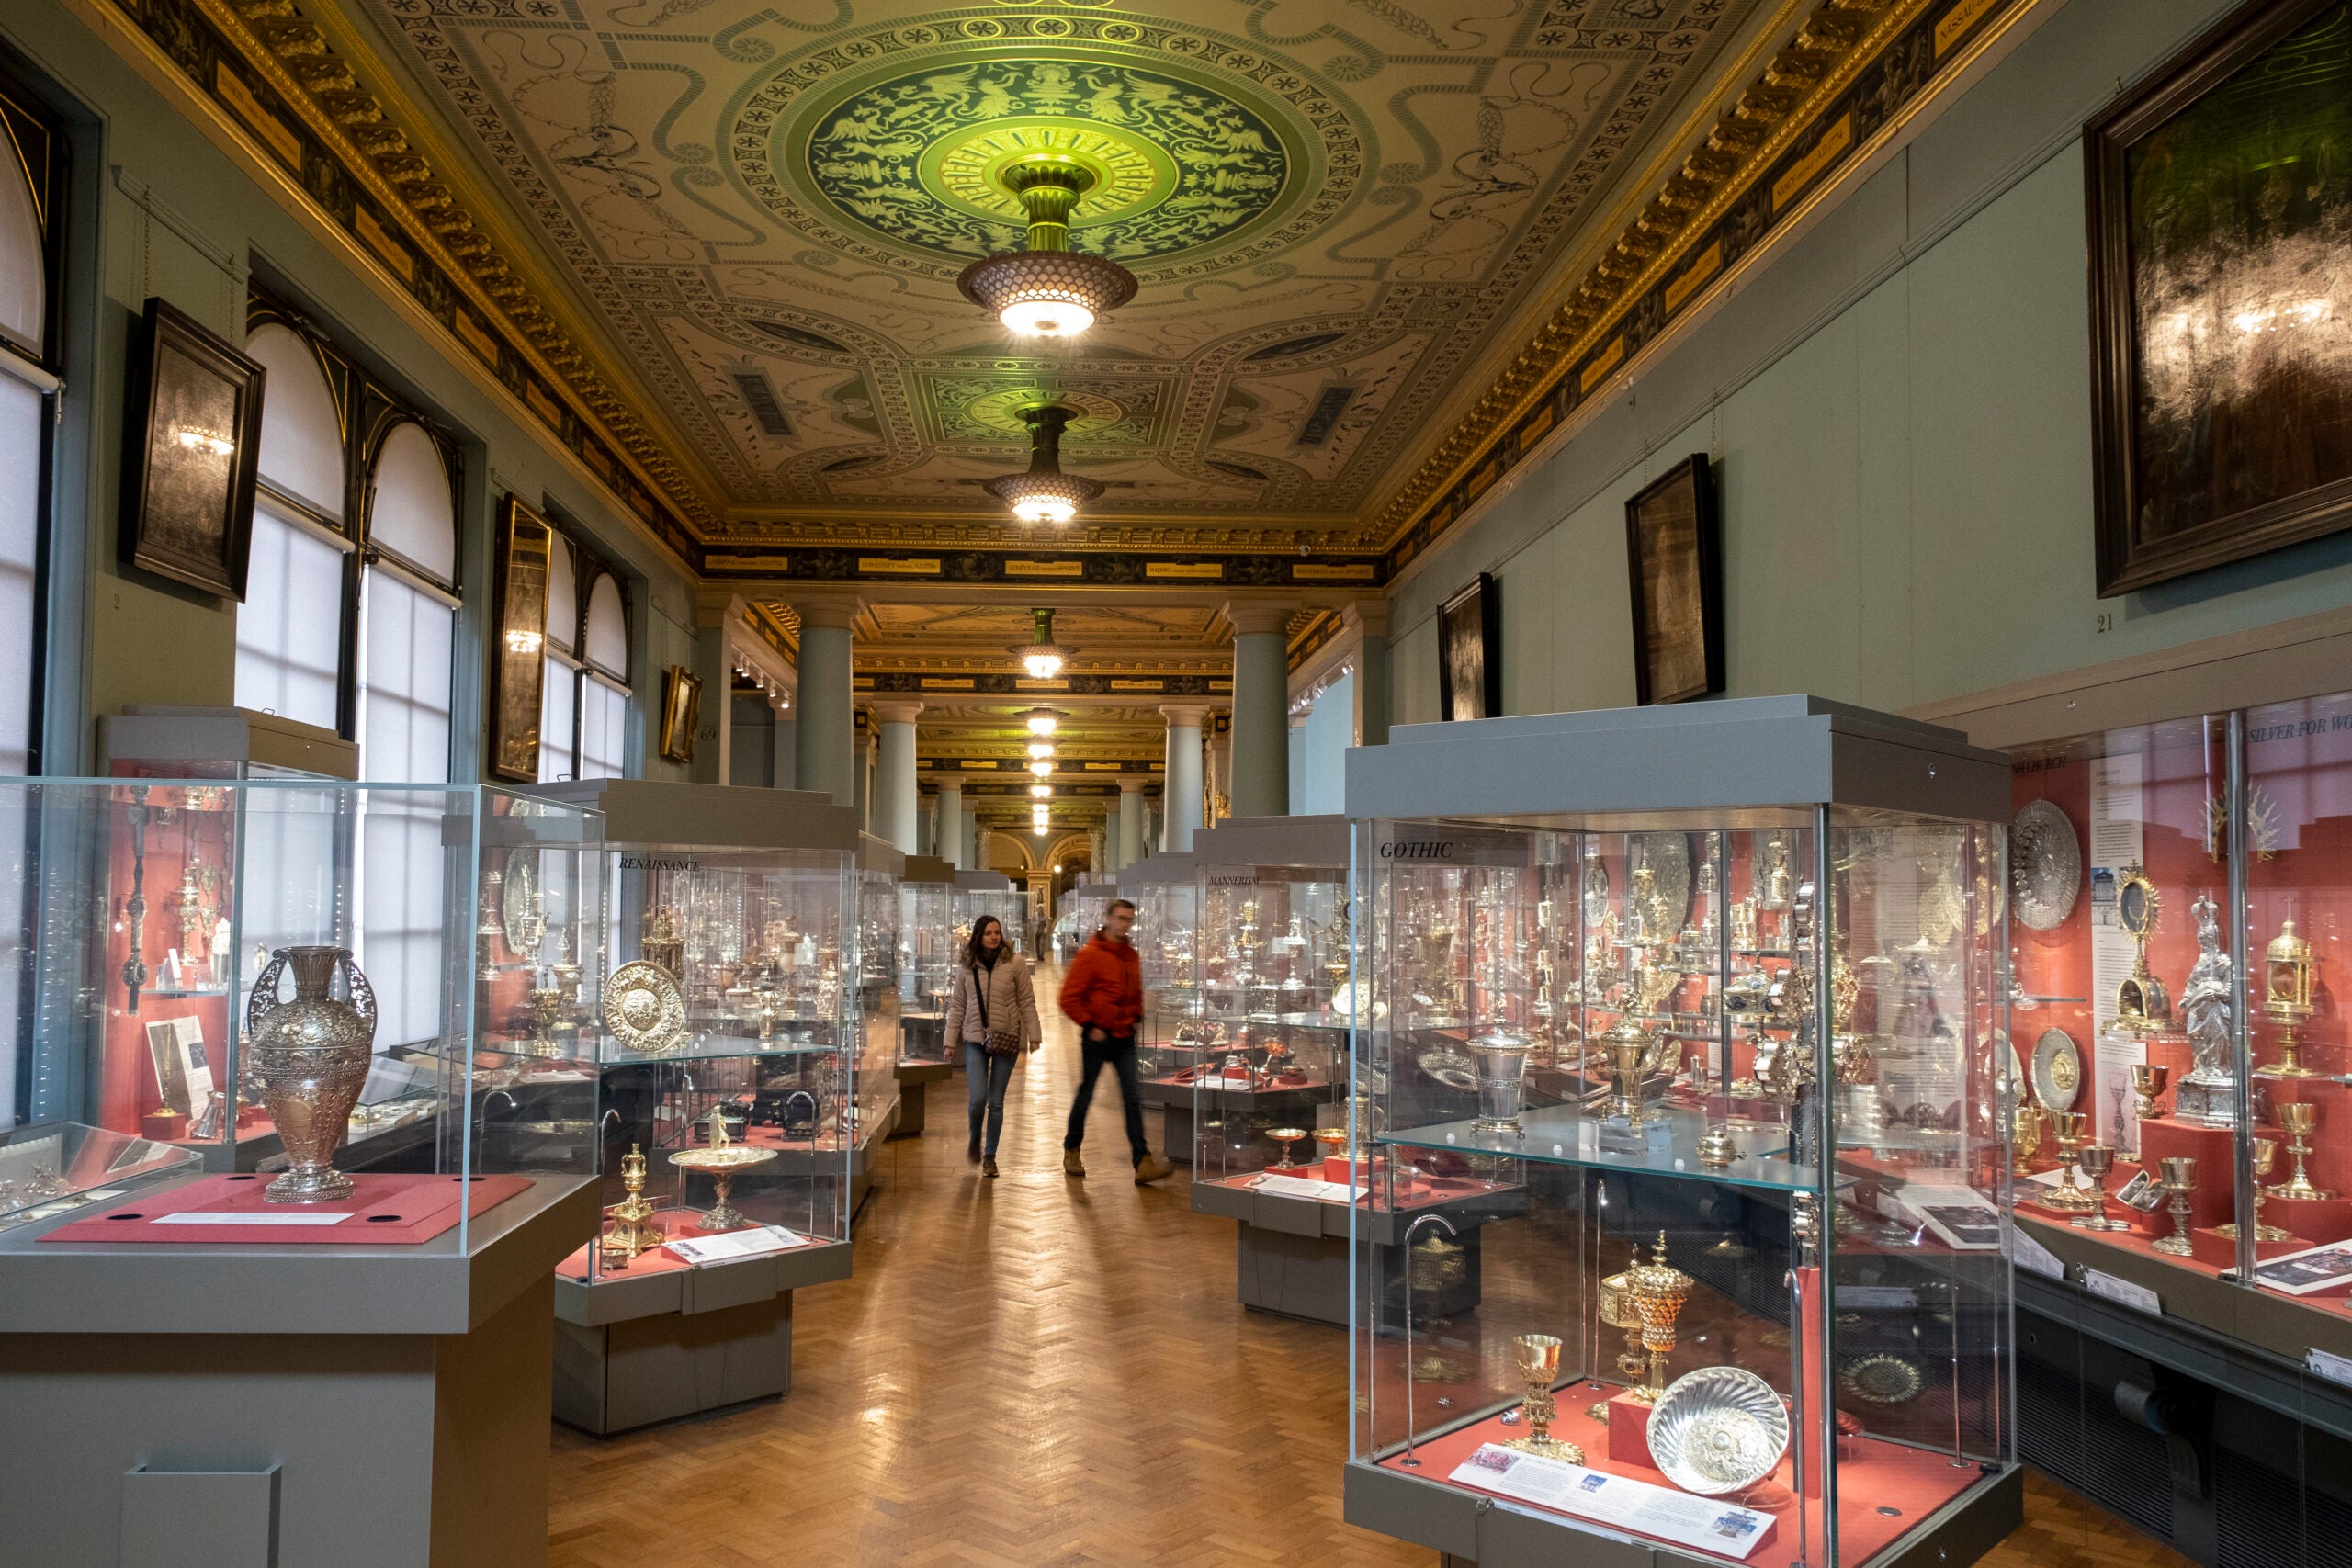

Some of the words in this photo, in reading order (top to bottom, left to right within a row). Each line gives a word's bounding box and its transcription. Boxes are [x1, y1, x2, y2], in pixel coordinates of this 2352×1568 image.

[2098, 613, 2113, 634] 21
[700, 728, 716, 741] 69
[2248, 723, 2294, 744] SILVER
[2299, 718, 2327, 737] FOR
[1380, 841, 1453, 859] GOTHIC
[618, 857, 701, 872] RENAISSANCE
[1209, 875, 1260, 886] MANNERISM
